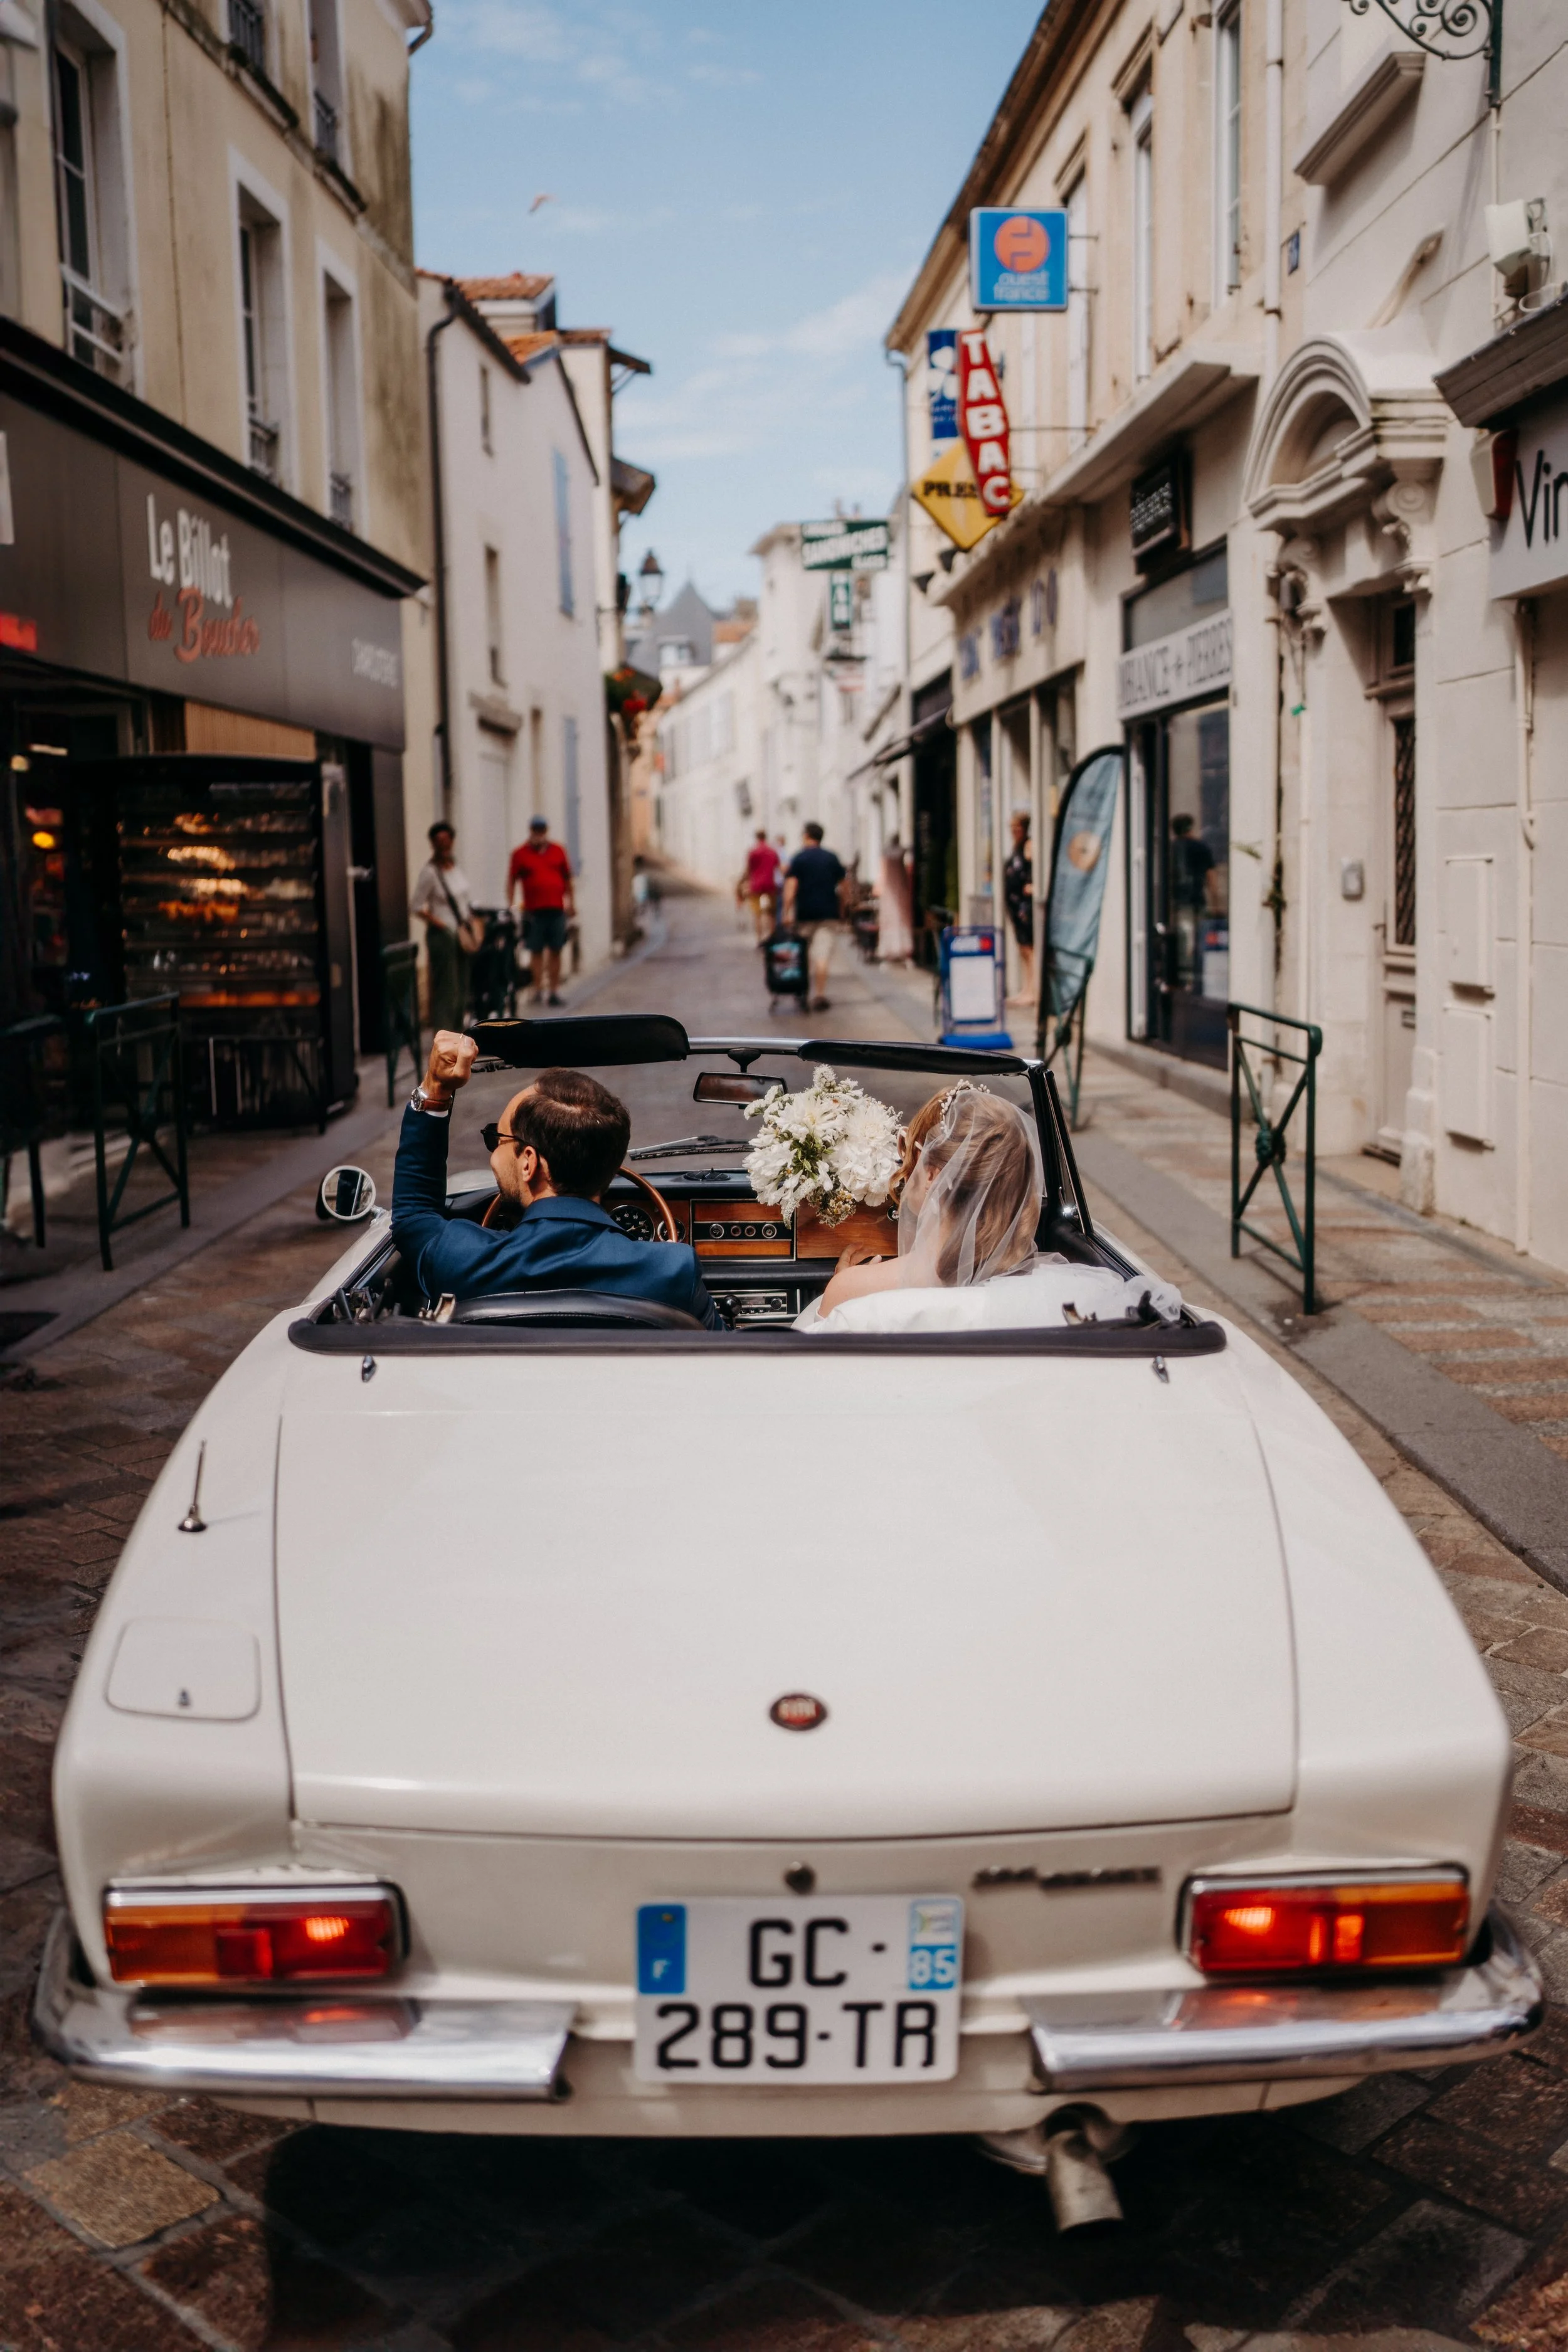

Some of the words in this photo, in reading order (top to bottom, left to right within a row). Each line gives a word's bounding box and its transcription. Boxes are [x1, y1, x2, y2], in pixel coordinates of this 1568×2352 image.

[998, 270, 1049, 285] ouest
[993, 282, 1050, 302] france
[961, 332, 1010, 507] TABAC
[924, 480, 980, 498] PRES
[147, 492, 175, 586] Le
[177, 508, 233, 610] Billot
[911, 1948, 956, 1985] 85
